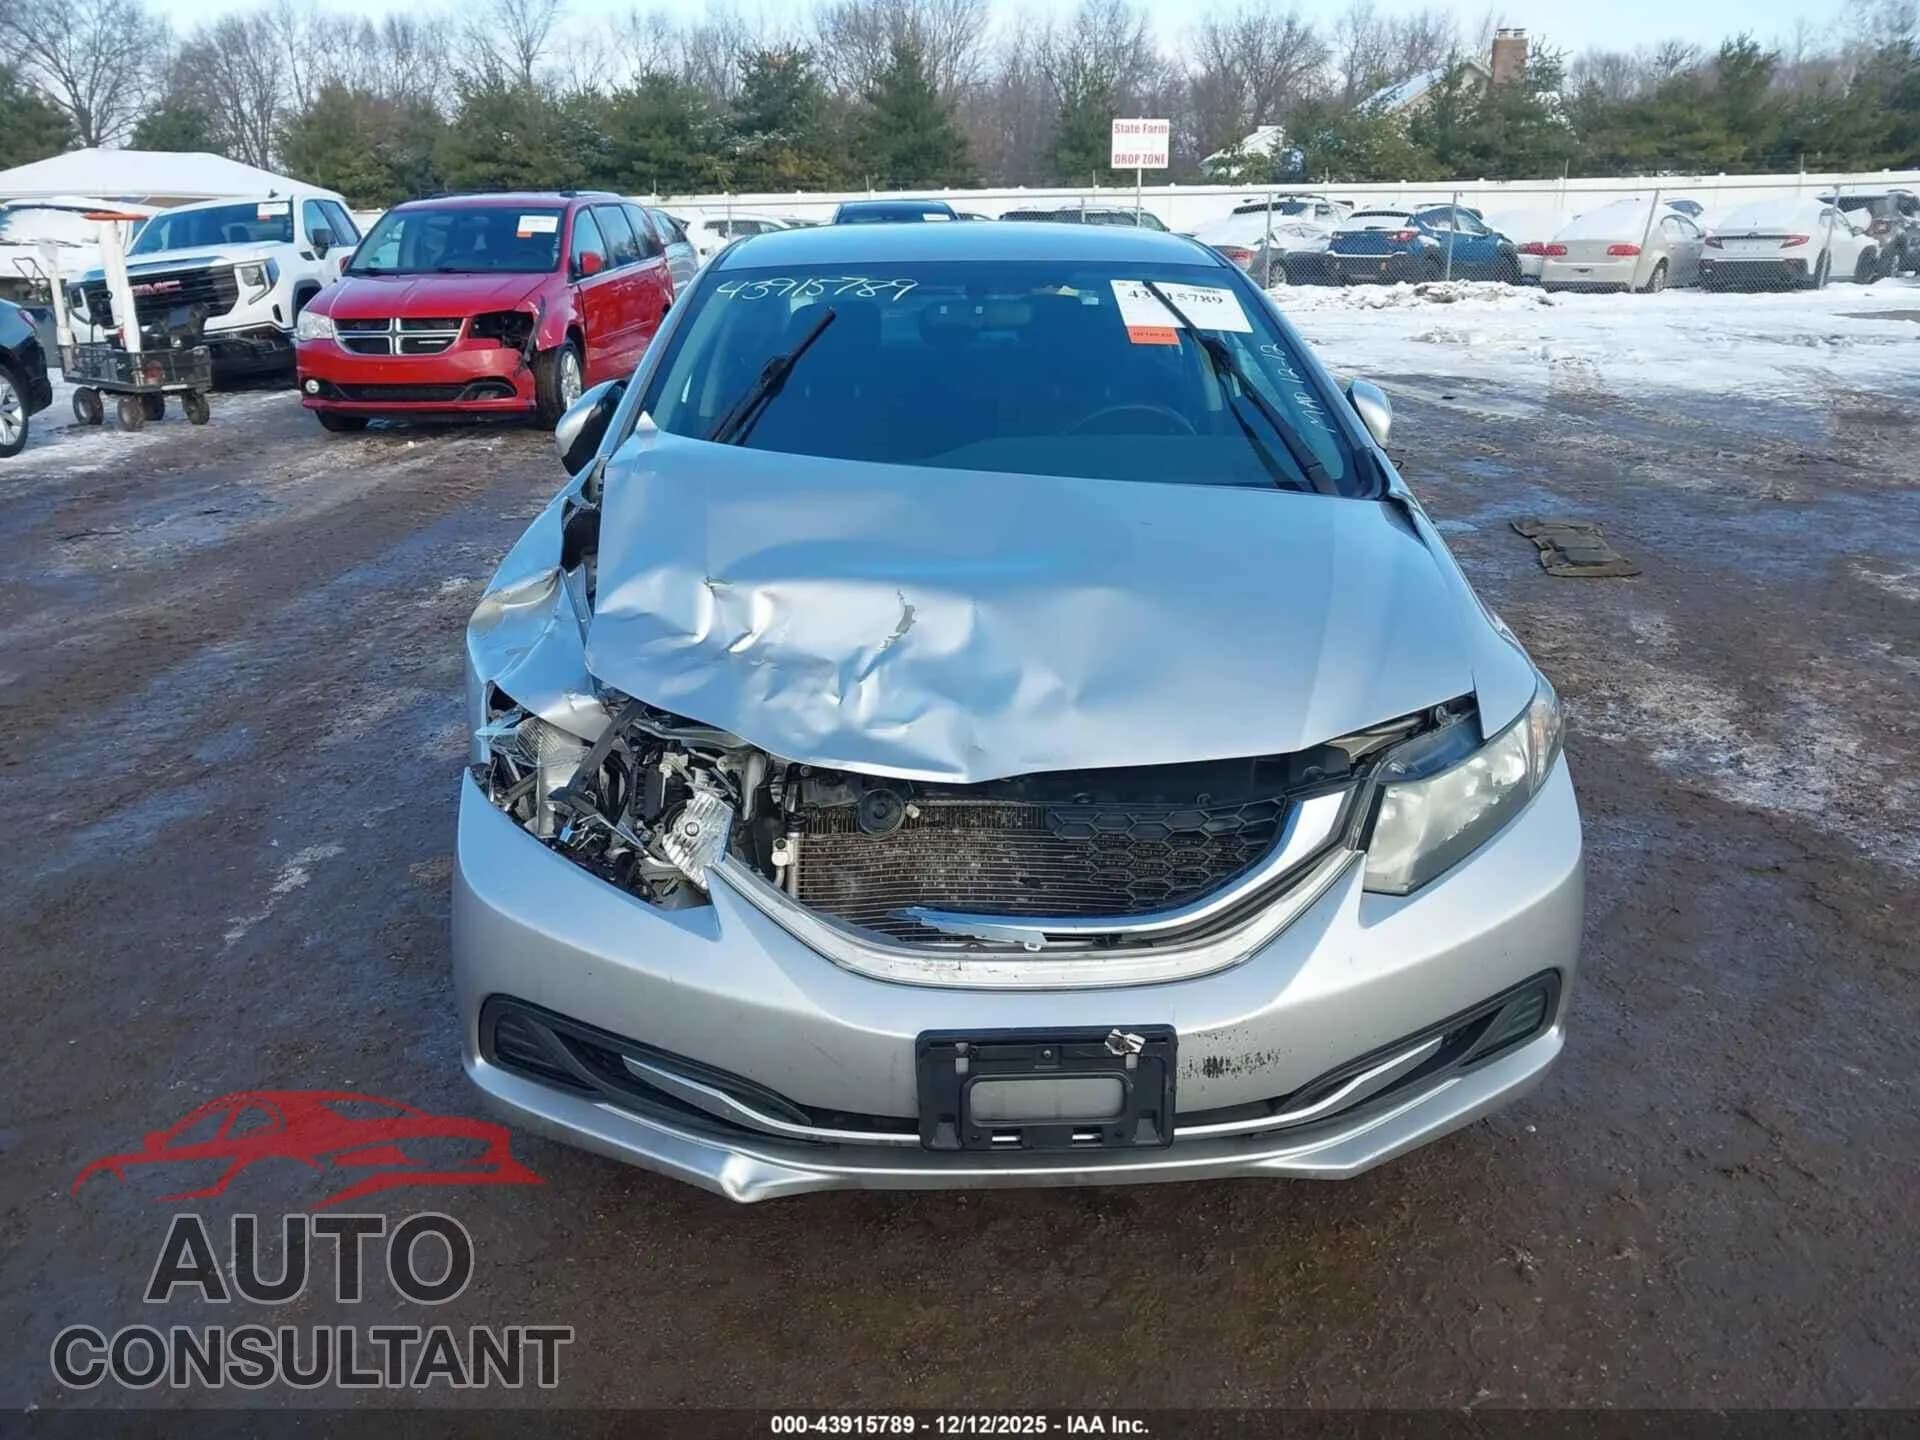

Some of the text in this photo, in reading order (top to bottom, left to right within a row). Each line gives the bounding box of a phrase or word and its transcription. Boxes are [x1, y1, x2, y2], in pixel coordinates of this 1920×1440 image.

[1114, 123, 1168, 134] State Farm
[1114, 154, 1166, 165] DROP ZONE
[716, 276, 919, 302] 43915789
[1128, 289, 1224, 305] 4315789
